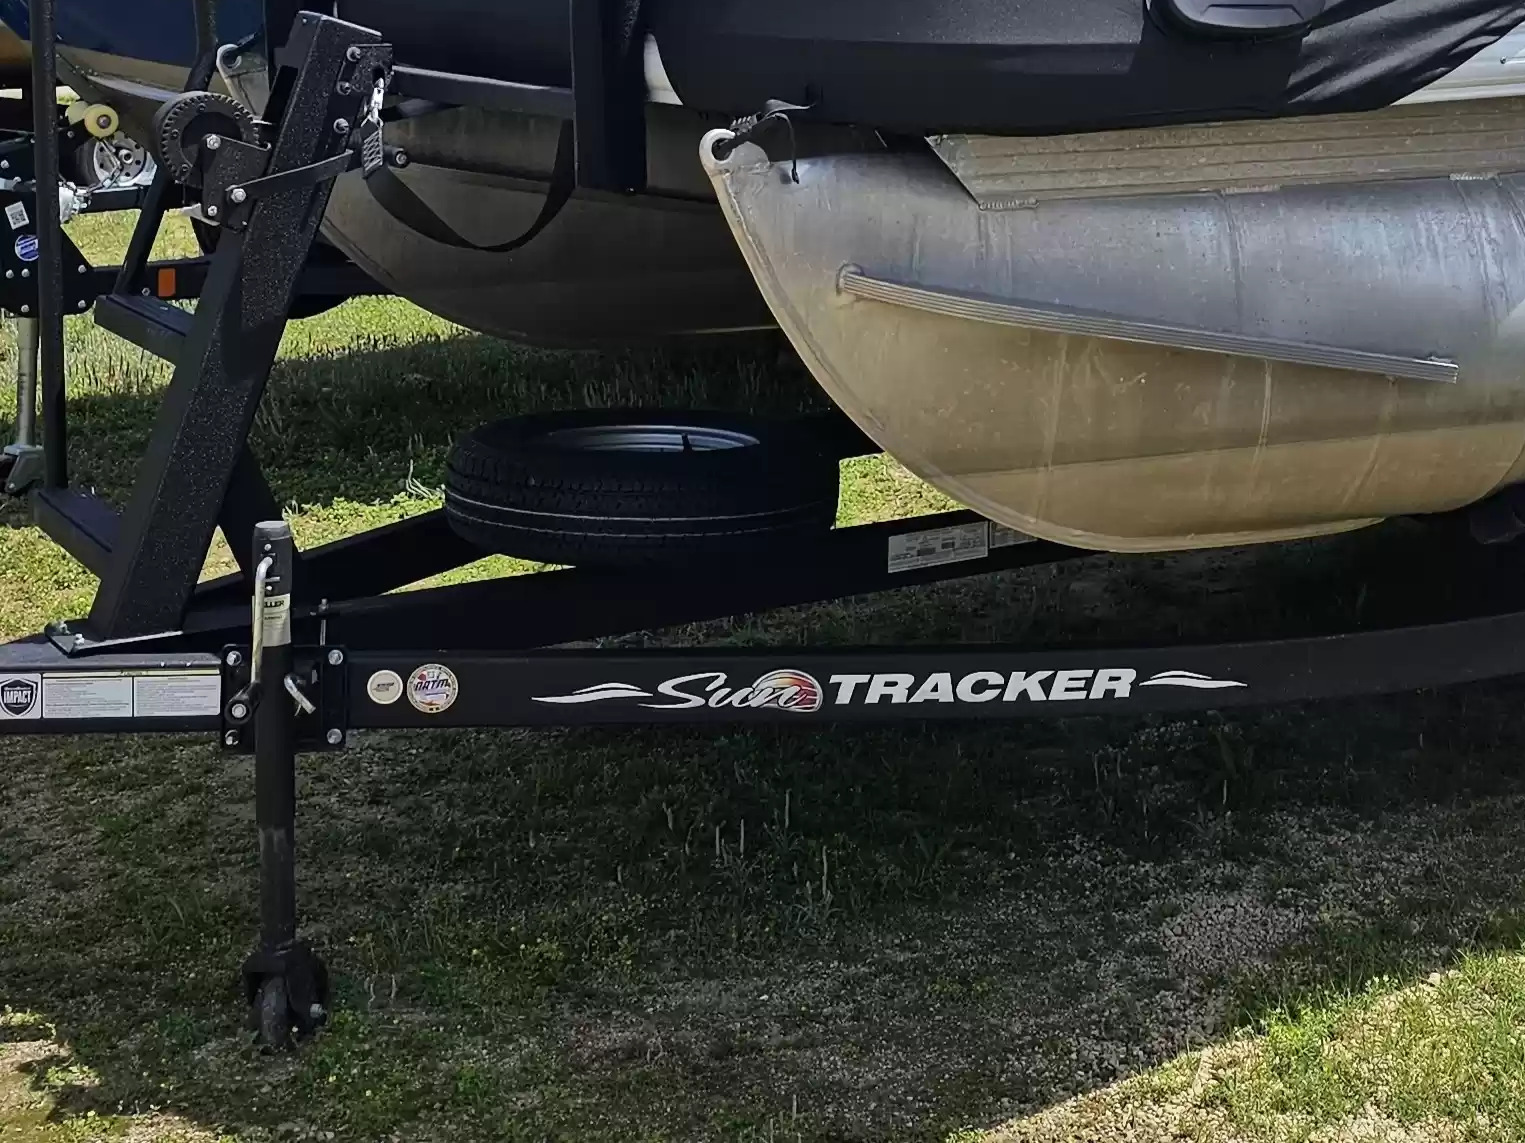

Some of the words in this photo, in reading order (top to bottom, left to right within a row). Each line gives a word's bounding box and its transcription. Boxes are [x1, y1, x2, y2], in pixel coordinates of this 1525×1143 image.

[3, 690, 32, 704] IMPACT
[637, 672, 808, 709] Sun
[828, 668, 1138, 705] TRACKER
